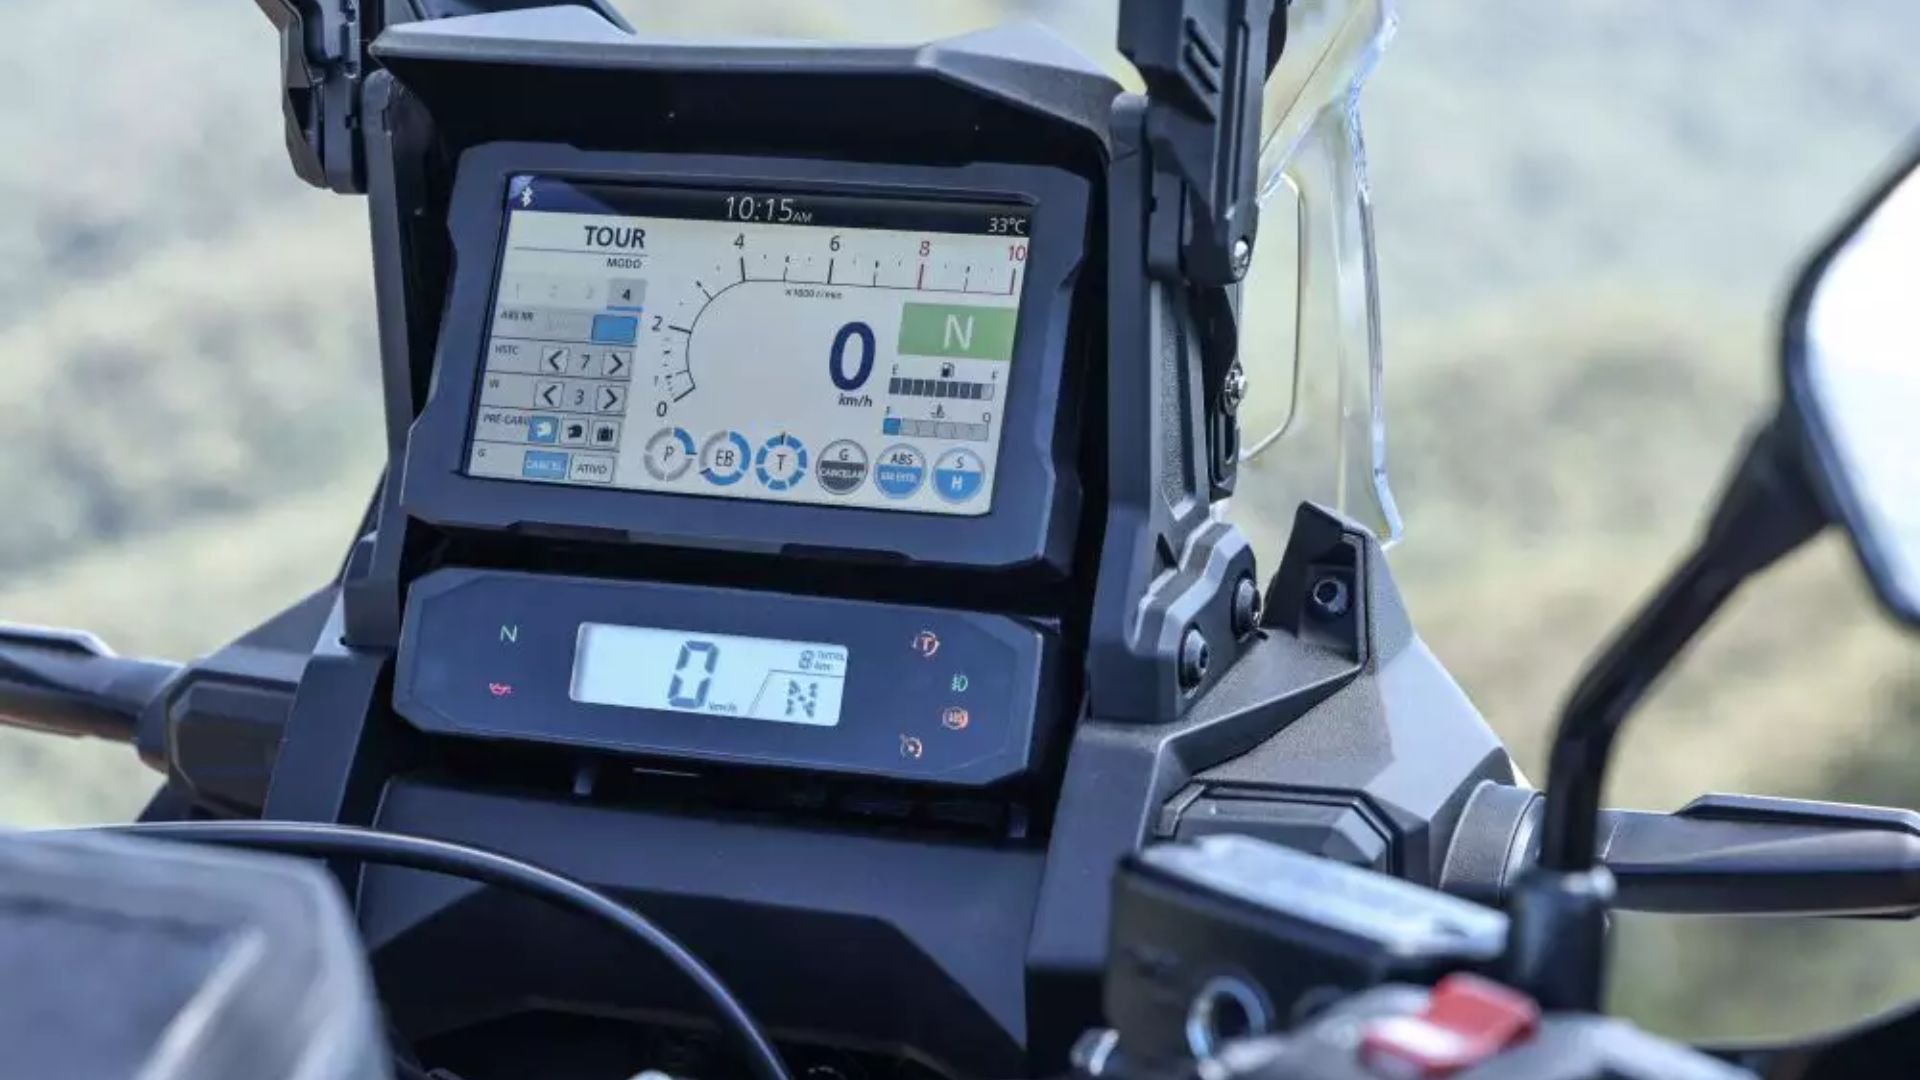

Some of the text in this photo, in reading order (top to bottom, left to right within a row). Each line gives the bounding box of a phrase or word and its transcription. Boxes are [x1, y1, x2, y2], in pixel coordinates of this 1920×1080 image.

[725, 195, 812, 223] 10:15AM
[987, 217, 1026, 234] 33°C
[584, 225, 647, 249] TOUR
[733, 233, 745, 249] 4
[830, 235, 841, 251] 6
[919, 240, 930, 257] 8
[1008, 245, 1027, 261] 10
[606, 257, 643, 269] MODO
[622, 288, 631, 301] 4
[652, 316, 663, 332] 2
[944, 314, 975, 350] N
[495, 345, 519, 355] HSTC
[829, 321, 876, 391] 0
[581, 354, 591, 370] 7
[575, 389, 585, 405] 3
[838, 393, 873, 408] km/h
[656, 401, 668, 417] 0
[664, 445, 675, 462] P
[716, 450, 734, 467] EB
[839, 448, 848, 460] G
[890, 453, 913, 465] ABS
[577, 465, 608, 475] ATIVO
[777, 454, 787, 471] T
[955, 456, 964, 469] S
[952, 476, 962, 490] H
[500, 624, 517, 643] N
[667, 640, 719, 709] 0
[785, 679, 818, 717] N
